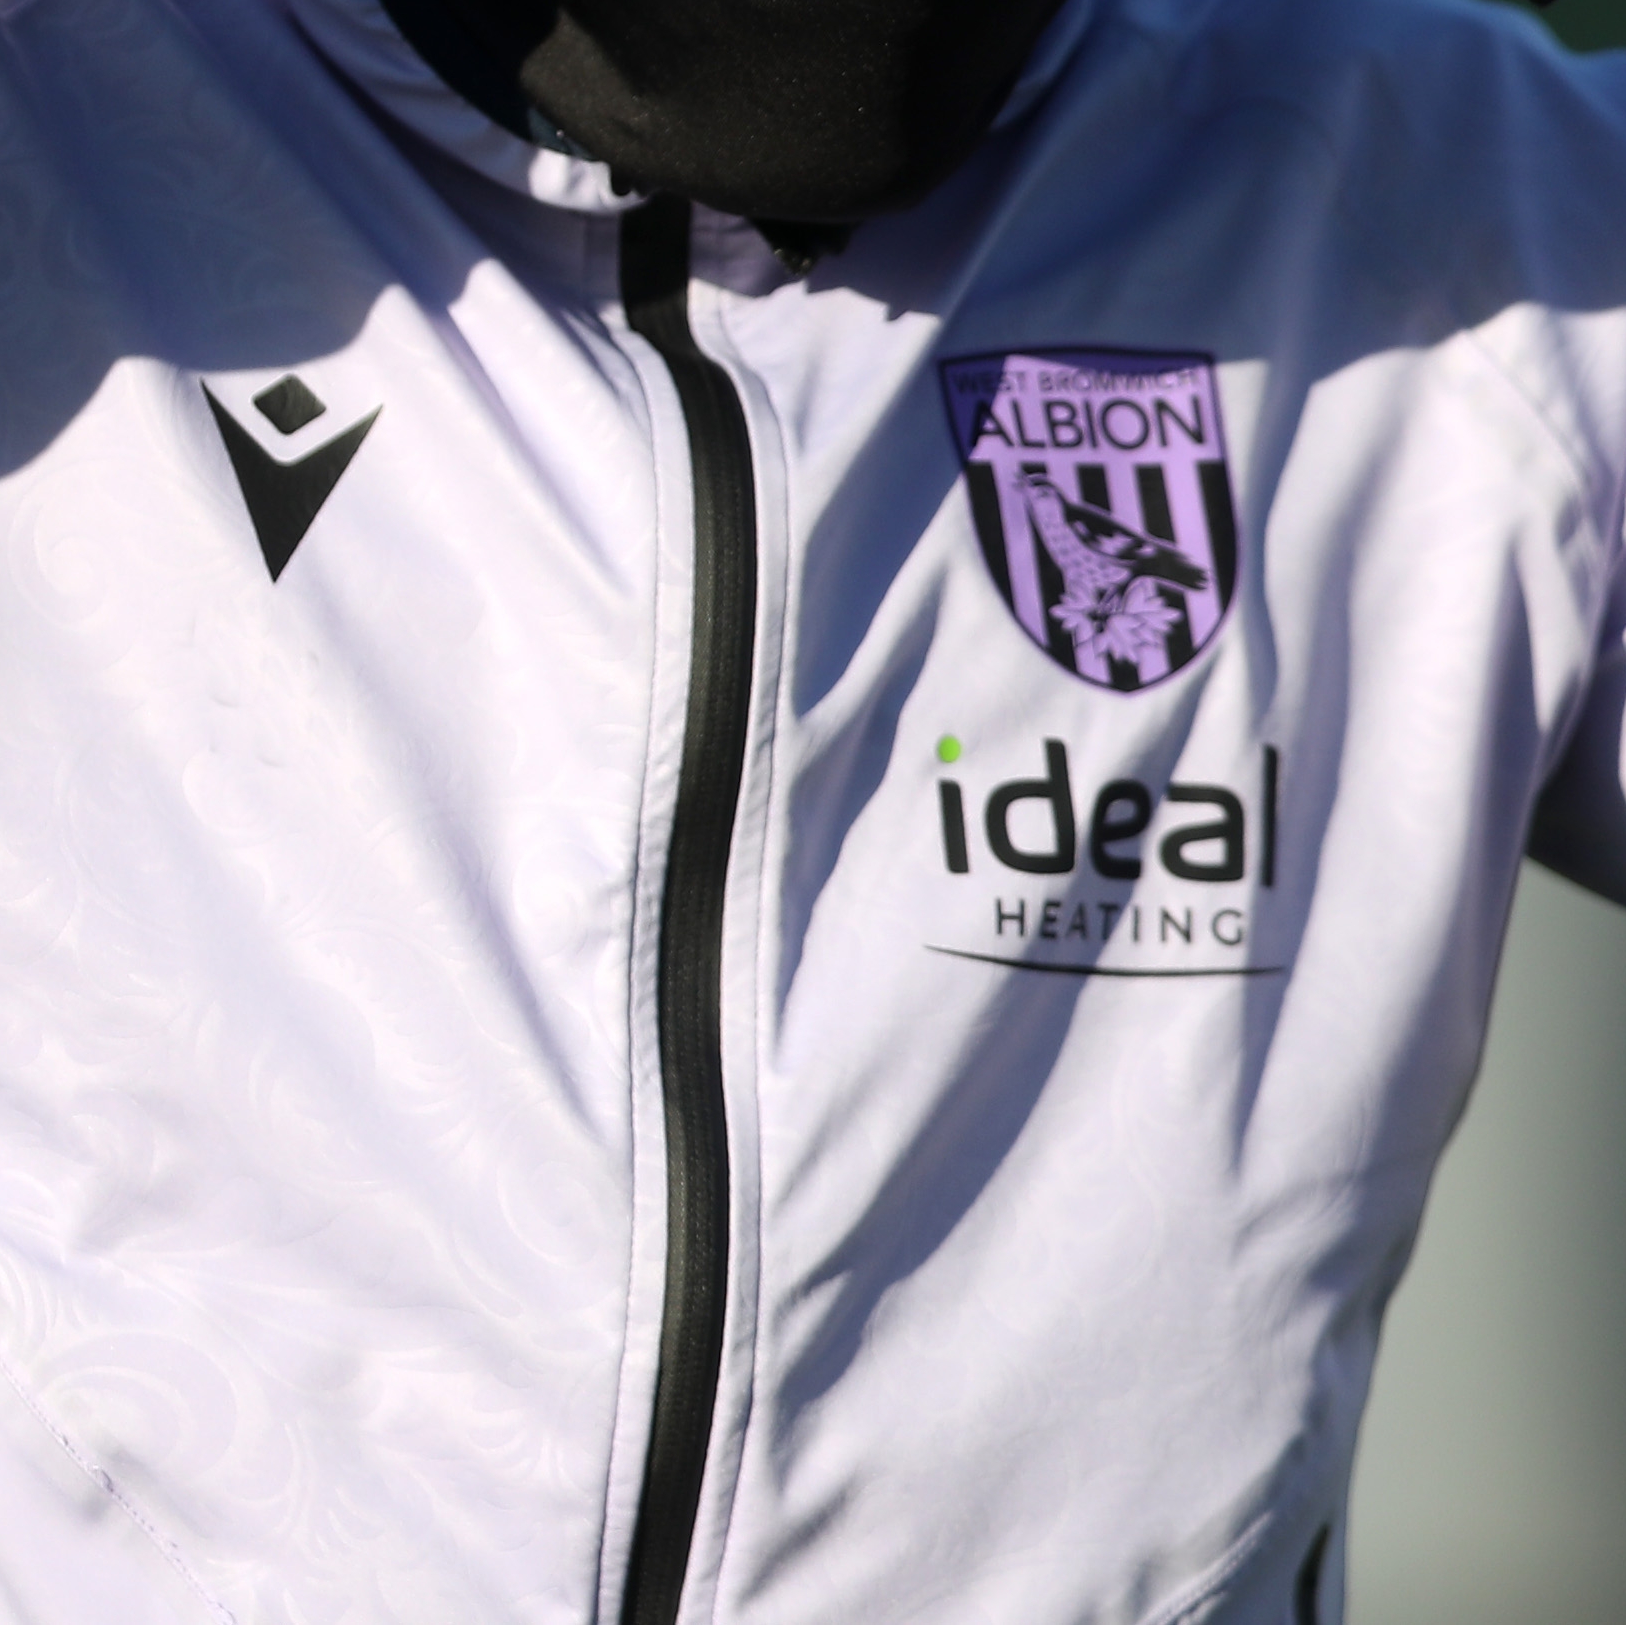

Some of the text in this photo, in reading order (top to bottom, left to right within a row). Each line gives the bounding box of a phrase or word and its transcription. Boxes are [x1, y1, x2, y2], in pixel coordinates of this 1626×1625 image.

[970, 395, 1206, 450] ALBION
[936, 734, 1279, 889] ideal
[995, 898, 1247, 947] HEATING
